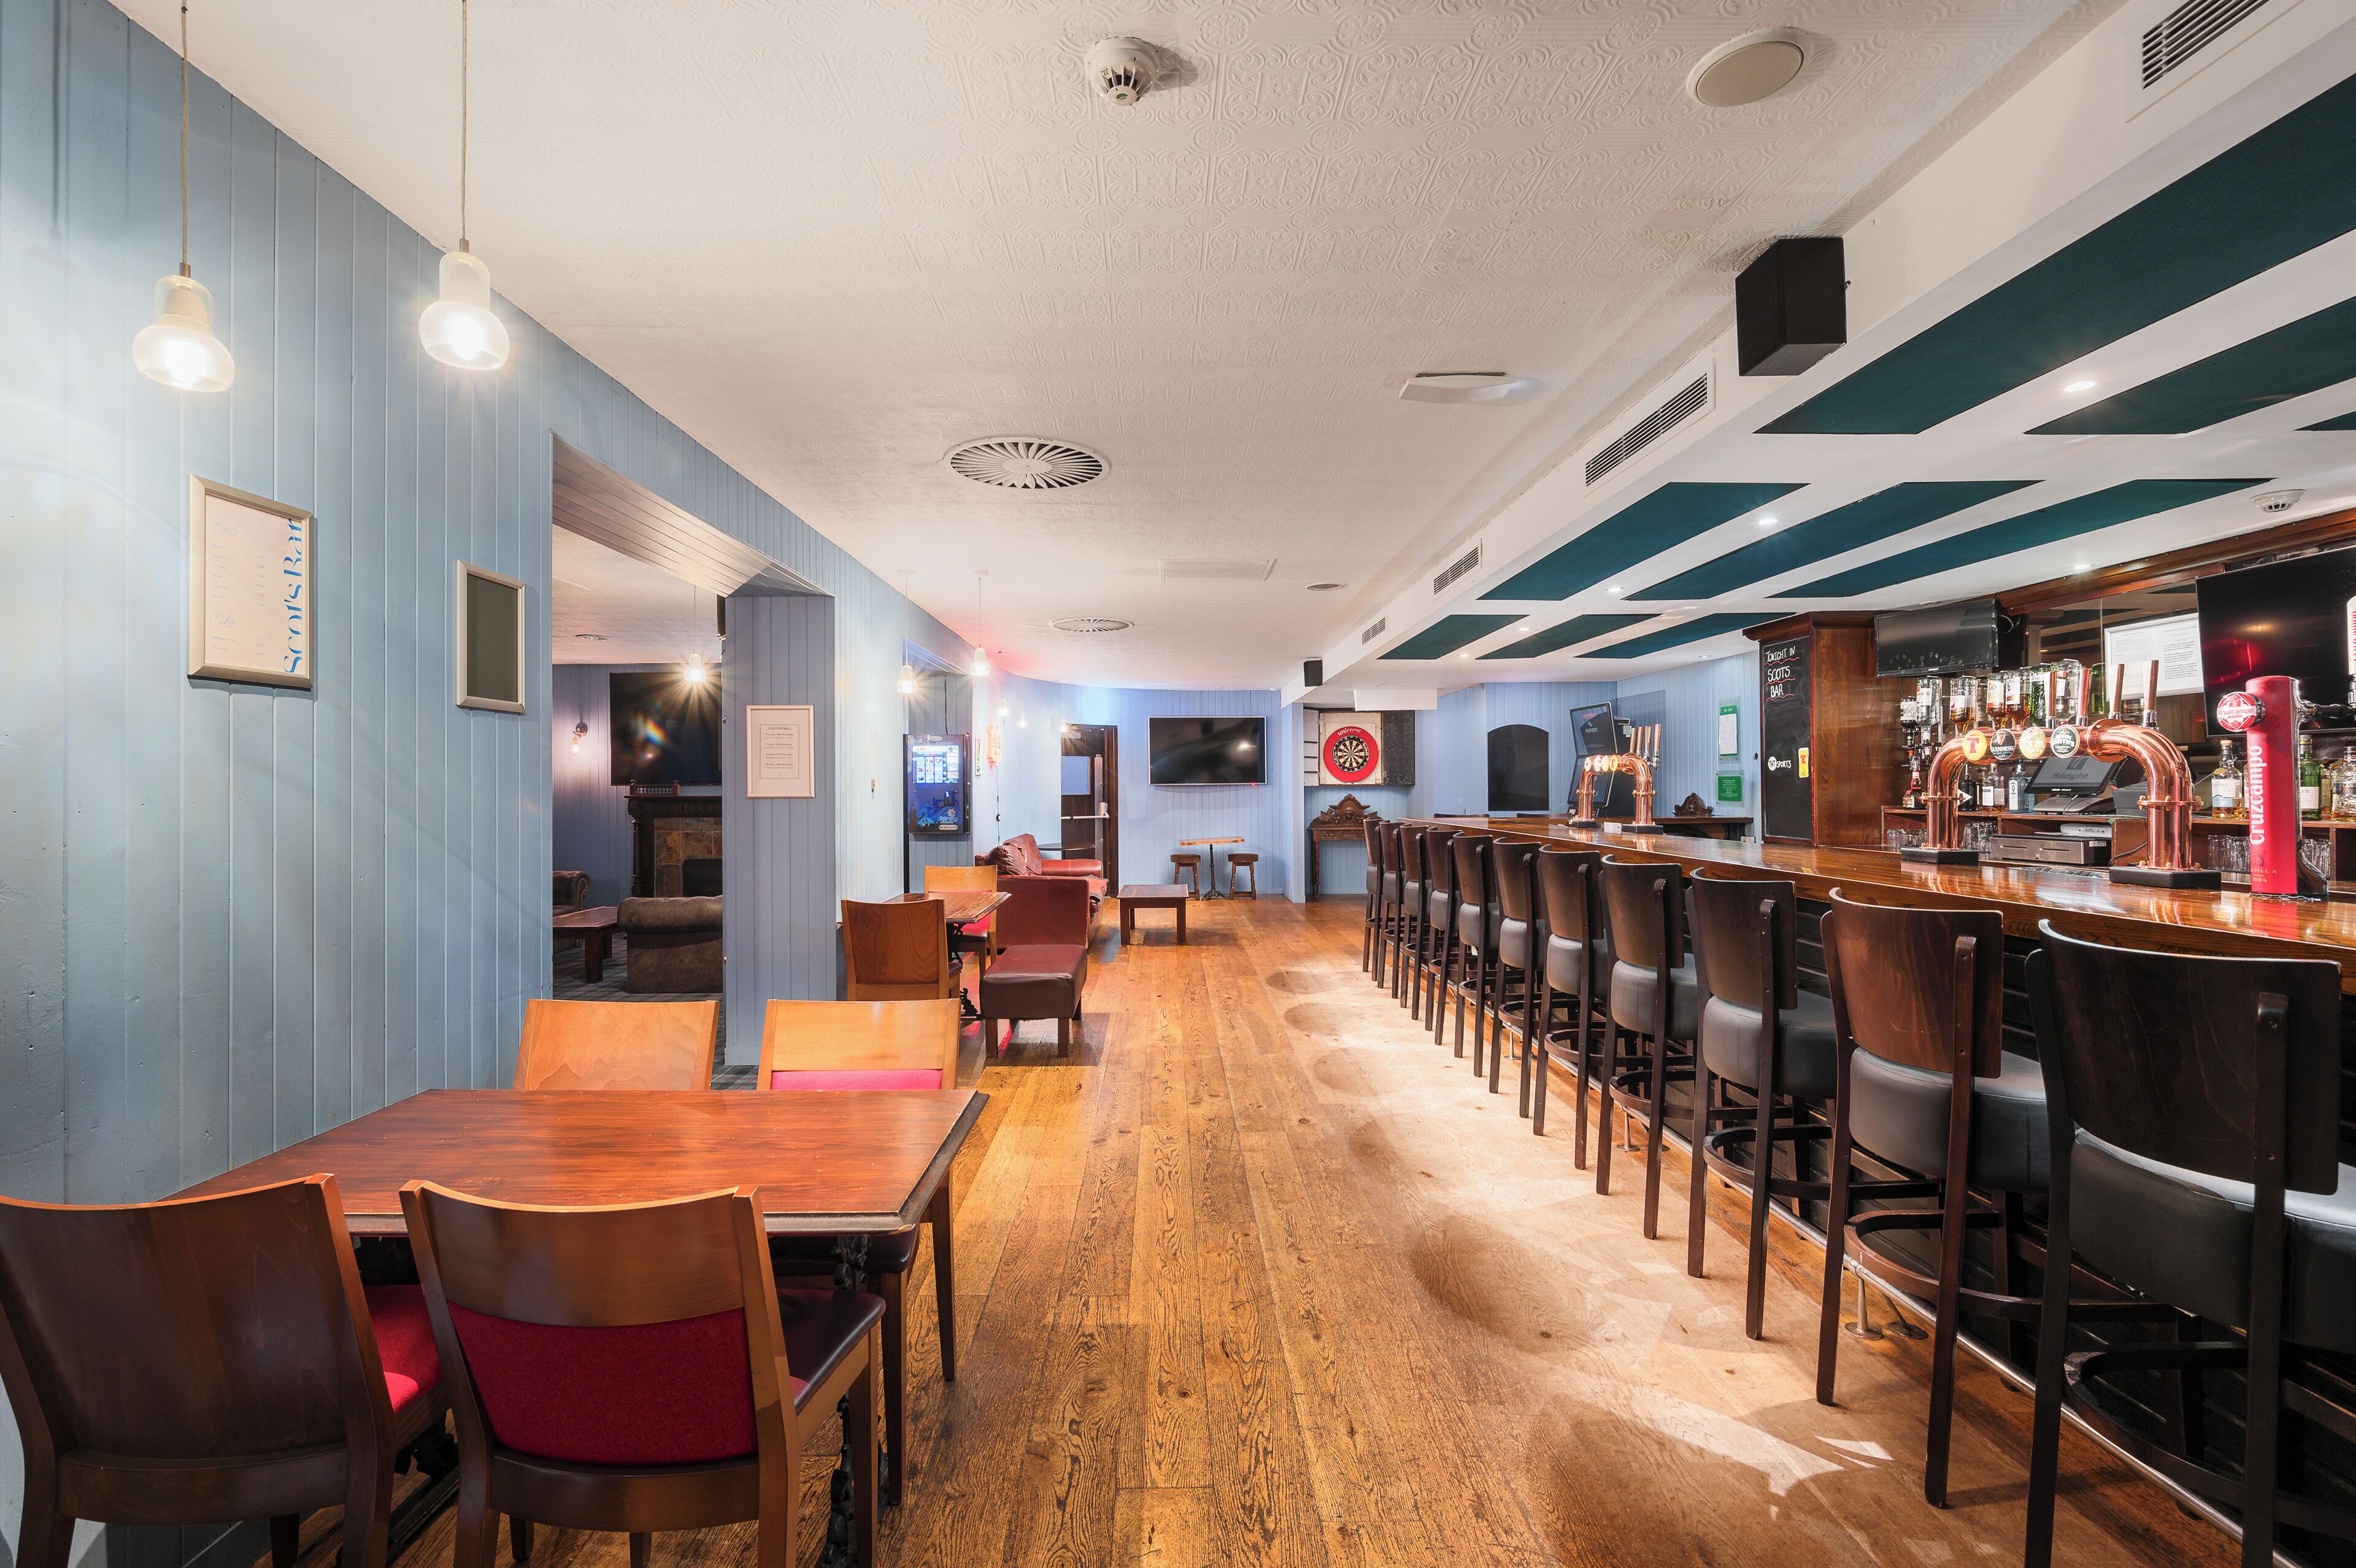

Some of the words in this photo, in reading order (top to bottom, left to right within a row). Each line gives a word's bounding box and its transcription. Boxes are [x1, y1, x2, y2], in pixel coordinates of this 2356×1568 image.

[283, 518, 302, 577] Bar
[209, 611, 236, 628] Cider
[283, 583, 302, 673] Scot's
[1765, 648, 1787, 662] TONIGHT
[1789, 645, 1796, 656] IN
[1770, 683, 1784, 698] BAR
[1967, 737, 1979, 753] T
[1800, 755, 1806, 764] T
[2249, 745, 2267, 845] Cruzcampo
